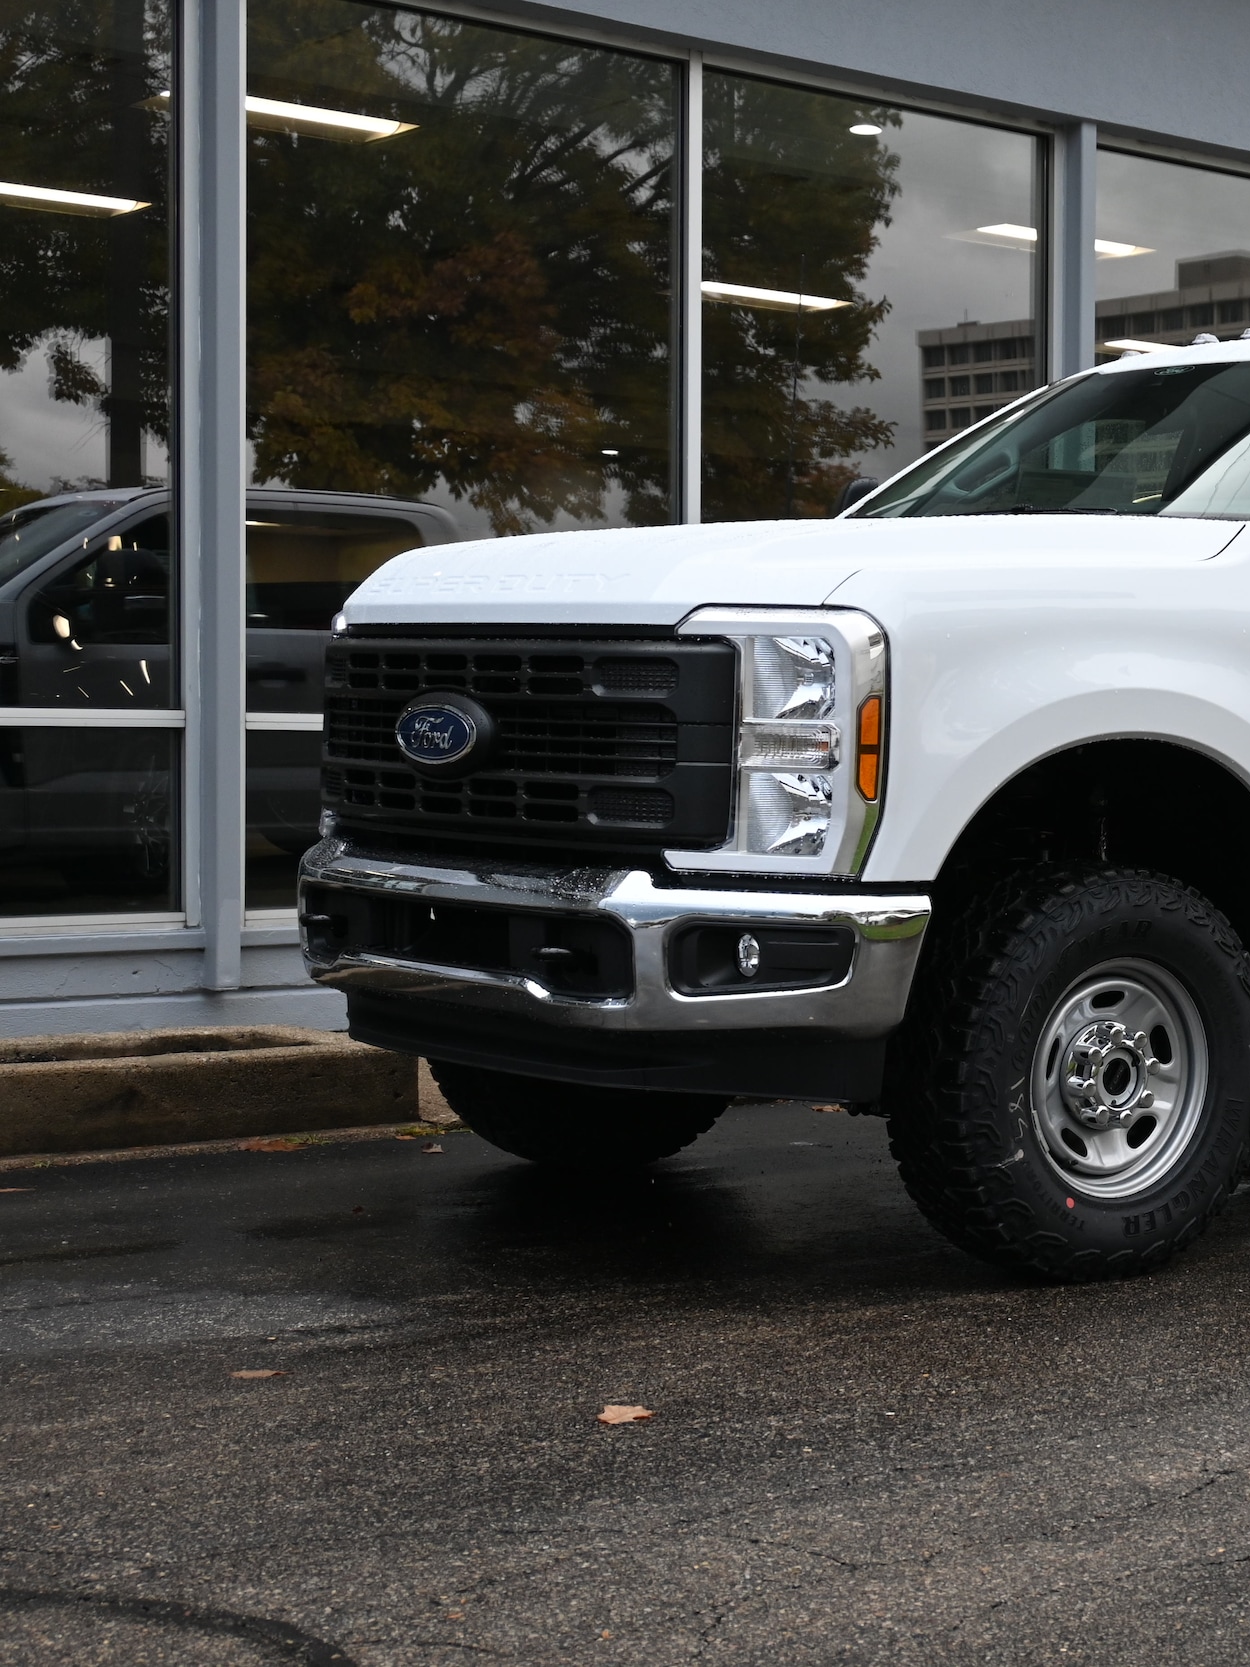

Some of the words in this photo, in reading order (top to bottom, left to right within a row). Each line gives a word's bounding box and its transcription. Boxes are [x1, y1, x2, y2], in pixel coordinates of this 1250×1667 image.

[366, 574, 490, 595] SUPER
[491, 572, 632, 594] DUTY
[411, 716, 454, 750] Ford
[1122, 1096, 1246, 1238] WRANGLER
